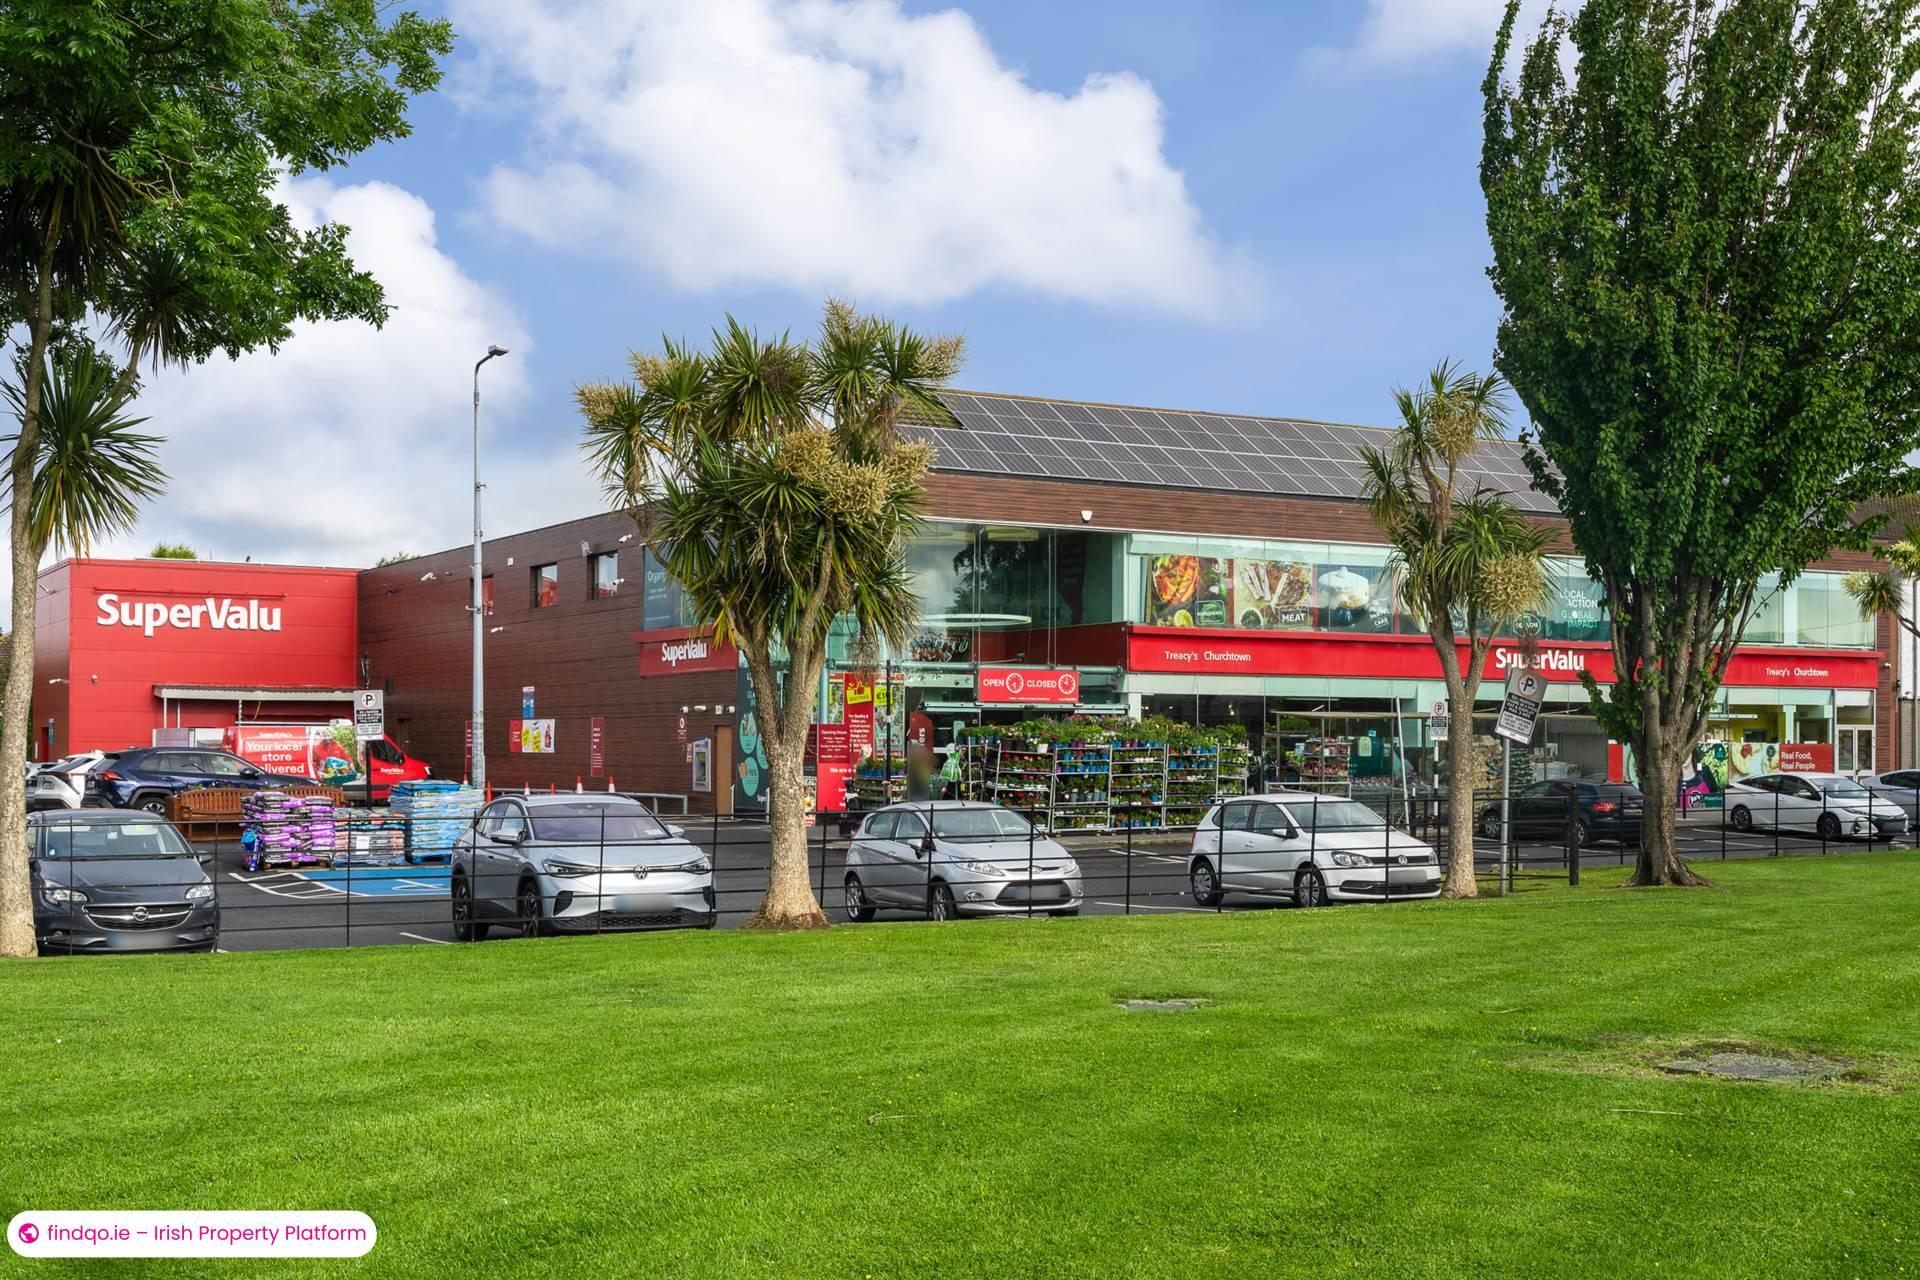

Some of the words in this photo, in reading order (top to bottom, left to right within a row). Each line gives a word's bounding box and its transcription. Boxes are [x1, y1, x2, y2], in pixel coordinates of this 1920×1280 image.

[1568, 599, 1597, 608] ACTION
[97, 593, 281, 636] SuperValu
[1282, 613, 1305, 622] MEAT
[662, 640, 707, 666] SuperValu
[1165, 651, 1198, 662] Treacy's
[1204, 651, 1251, 661] Churchtown
[1766, 668, 1790, 677] Treacy's
[1794, 667, 1829, 676] Churchtown
[1027, 680, 1056, 688] CLOSED
[1523, 677, 1534, 691] P
[366, 695, 373, 705] P
[1437, 704, 1443, 713] P
[246, 741, 273, 752] Your
[274, 741, 303, 752] local
[261, 752, 292, 762] store
[1781, 752, 1794, 760] Real
[1795, 752, 1812, 761] Food,
[1795, 762, 1815, 771] People
